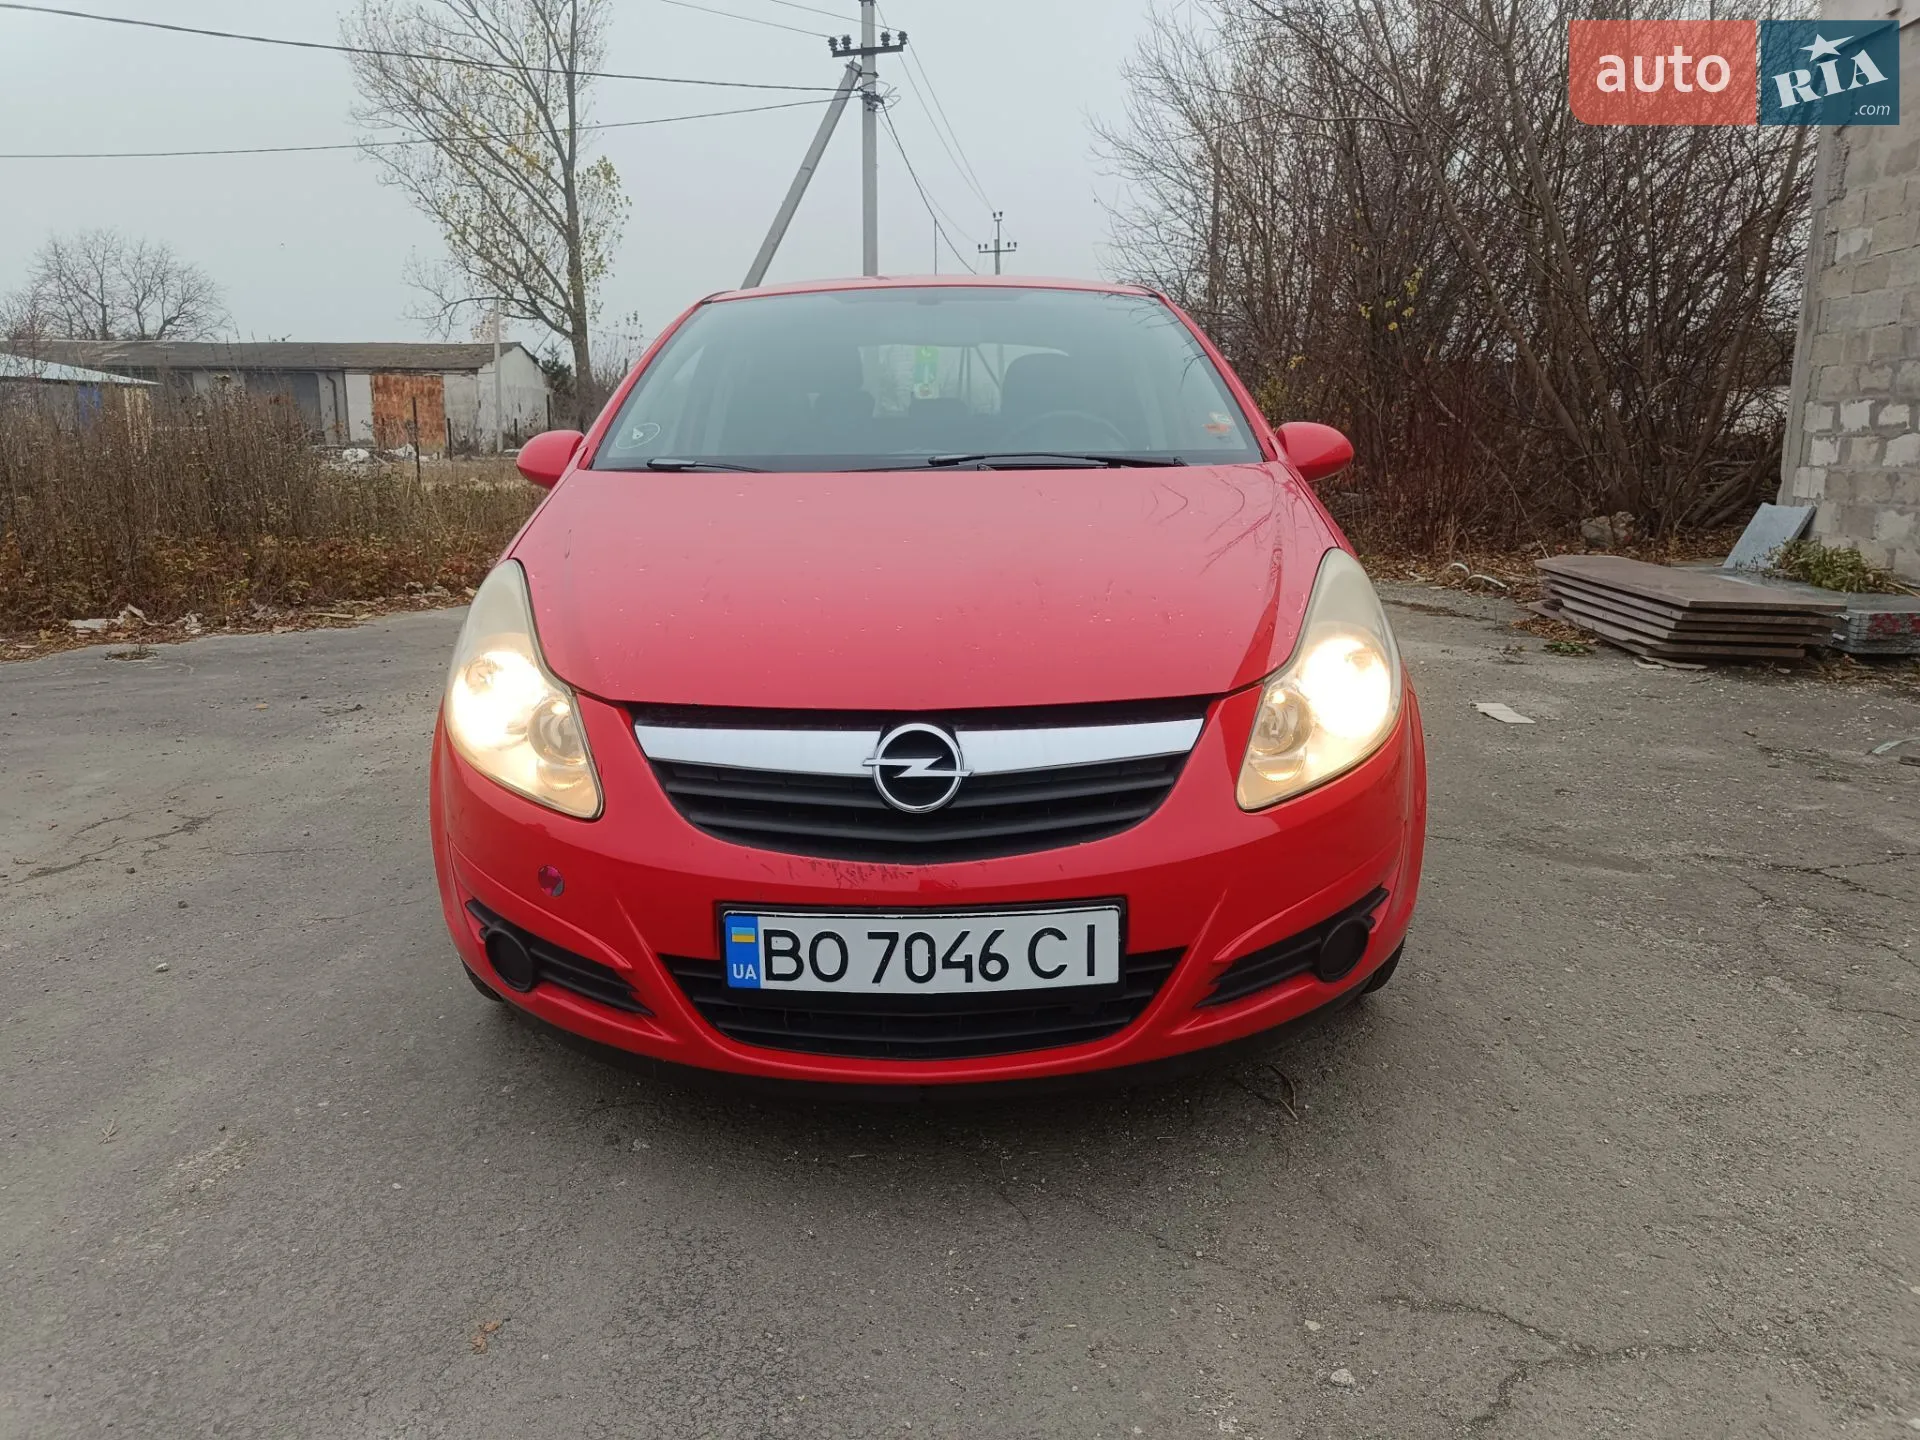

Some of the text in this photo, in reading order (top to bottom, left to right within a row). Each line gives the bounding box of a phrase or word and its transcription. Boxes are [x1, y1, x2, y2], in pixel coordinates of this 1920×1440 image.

[732, 963, 757, 980] UA
[762, 924, 1096, 985] BO 7046 CI
